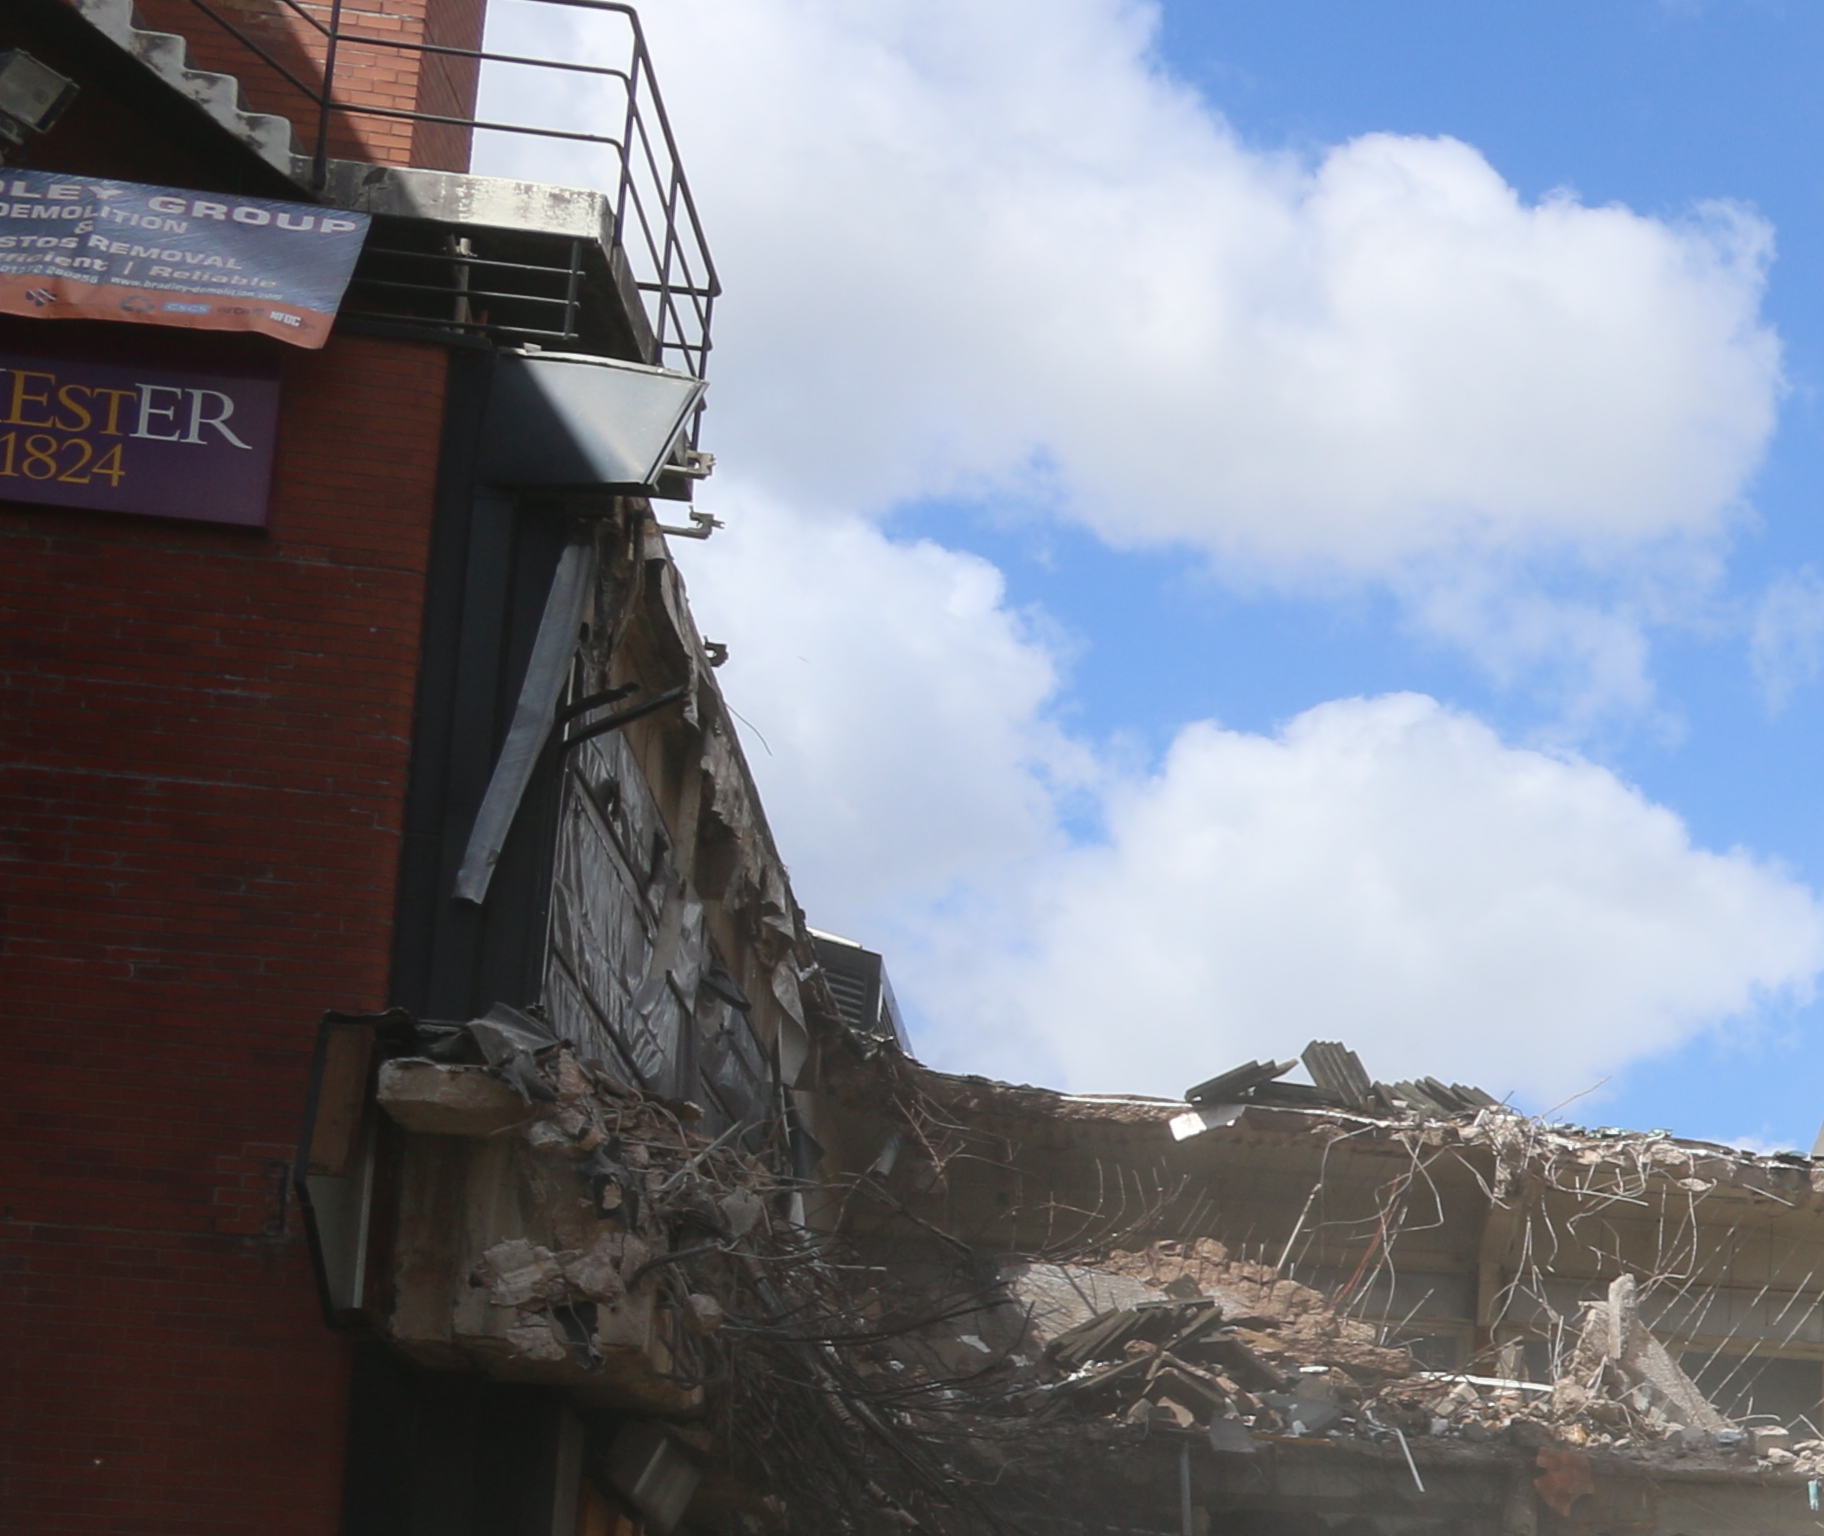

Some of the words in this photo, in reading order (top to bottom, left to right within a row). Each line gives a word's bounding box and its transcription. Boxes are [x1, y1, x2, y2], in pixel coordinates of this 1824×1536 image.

[0, 180, 124, 200] LEY
[147, 196, 357, 233] GROUP
[74, 220, 94, 234] &
[88, 234, 242, 270] REMOVAL
[111, 276, 283, 300] www.bradley-demolition.com
[149, 265, 277, 288] Reliable
[0, 368, 253, 450] ESTER
[0, 431, 126, 487] 1824
